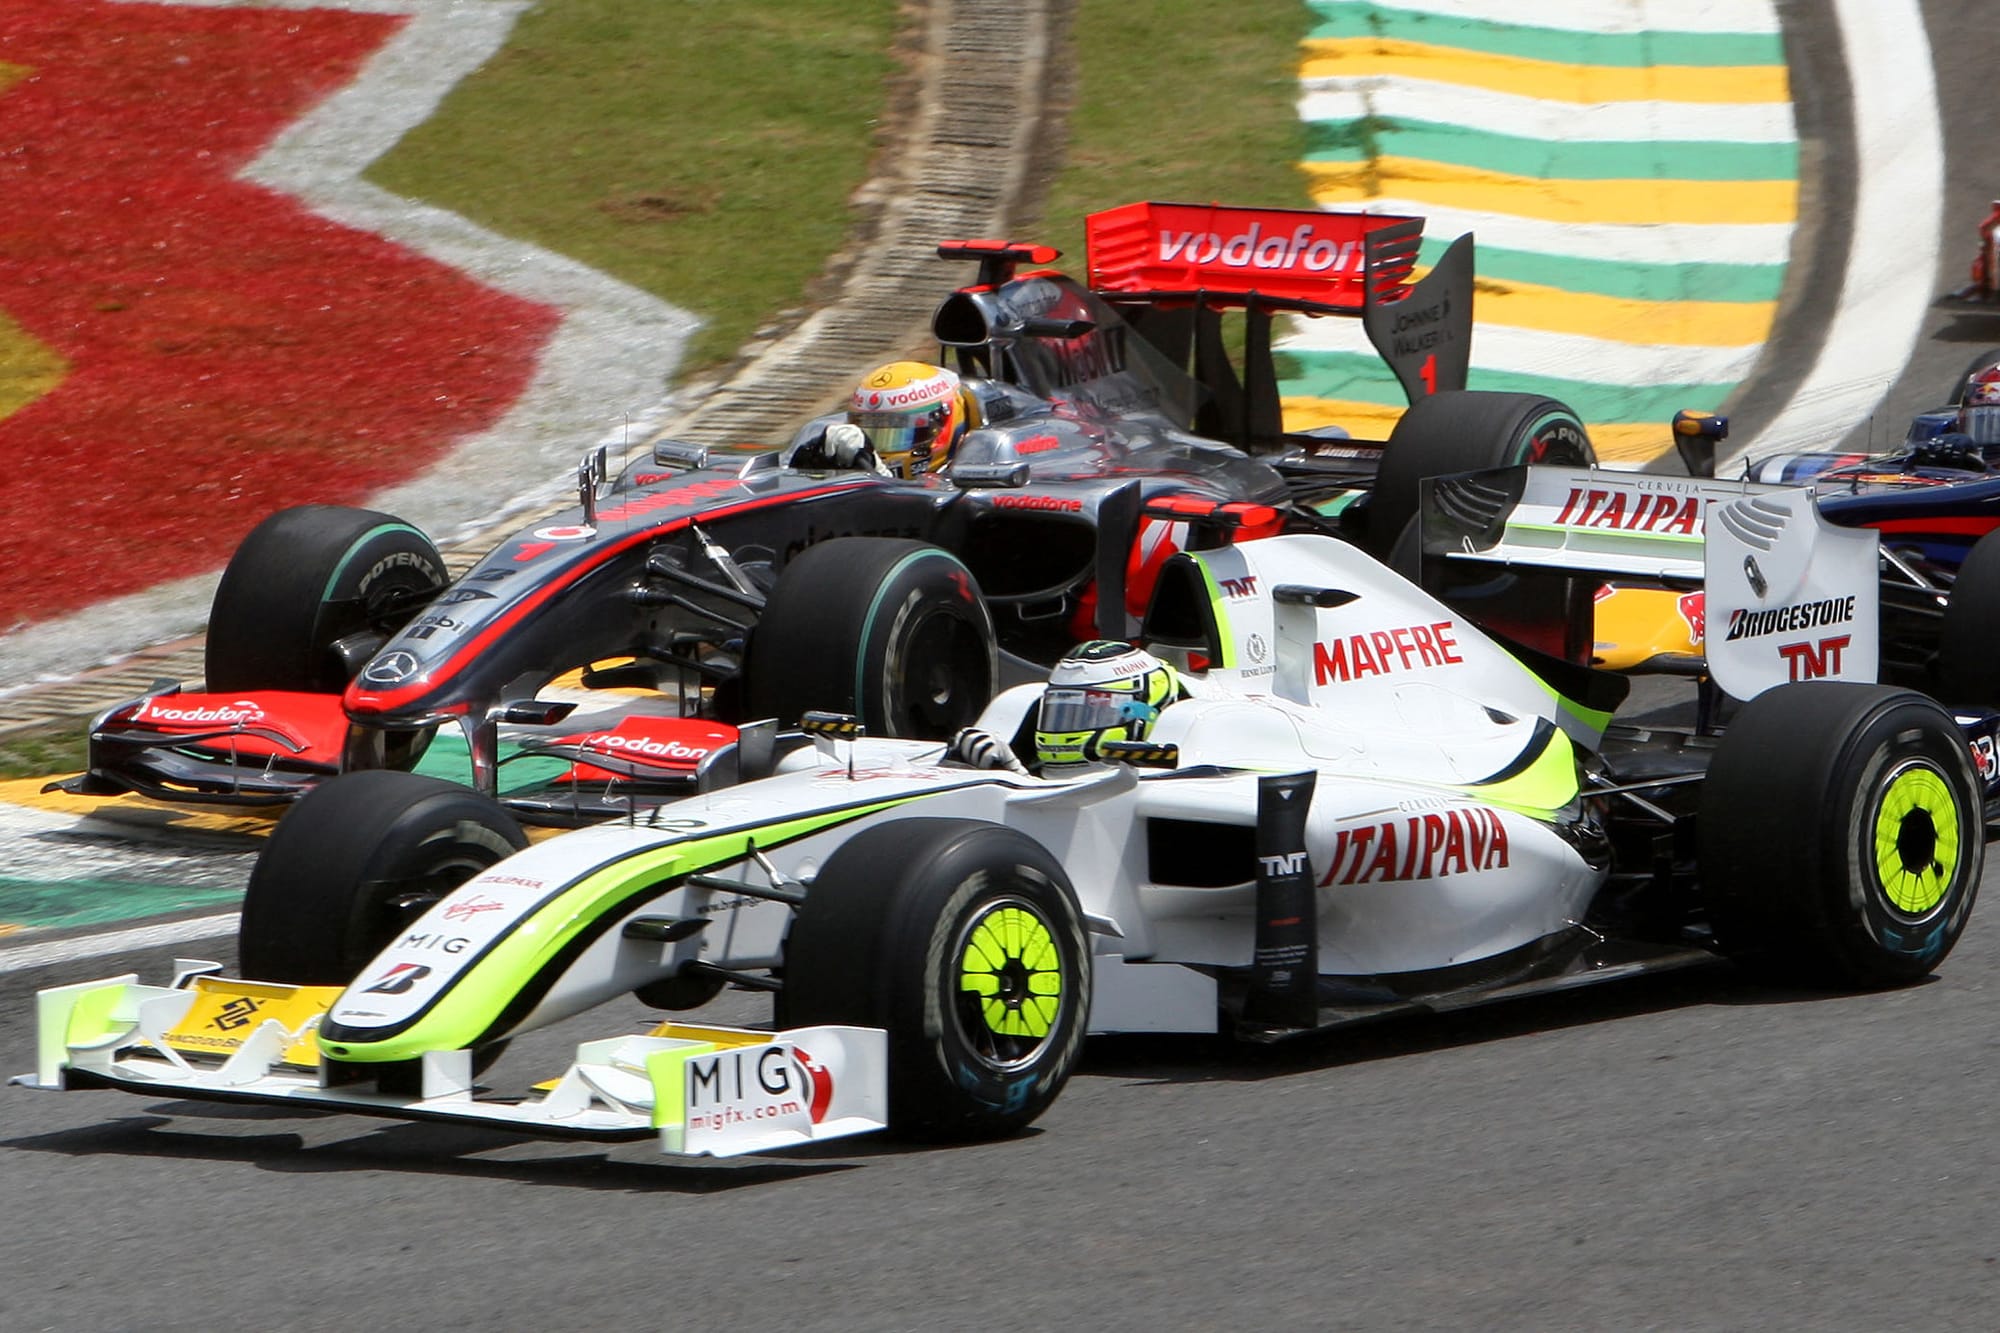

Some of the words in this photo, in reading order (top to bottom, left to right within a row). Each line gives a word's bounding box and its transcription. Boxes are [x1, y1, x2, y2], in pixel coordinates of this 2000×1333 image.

[1158, 220, 1366, 273] vodafon
[1418, 353, 1437, 396] 1
[992, 495, 1083, 513] vodafone
[1637, 480, 1701, 495] CERVEJA
[1552, 487, 1707, 535] ITAIPA
[1218, 575, 1258, 599] TNT
[1725, 595, 1856, 642] BRIDGESTONE
[1312, 621, 1464, 687] MAPFRE
[1778, 634, 1852, 682] TNT
[590, 734, 709, 760] vodafon
[1258, 851, 1307, 877] TNT
[1316, 808, 1510, 889] ITAIPAVA
[398, 933, 472, 955] MIG
[690, 1046, 793, 1108] MIG
[689, 1100, 801, 1132] migfx.com
